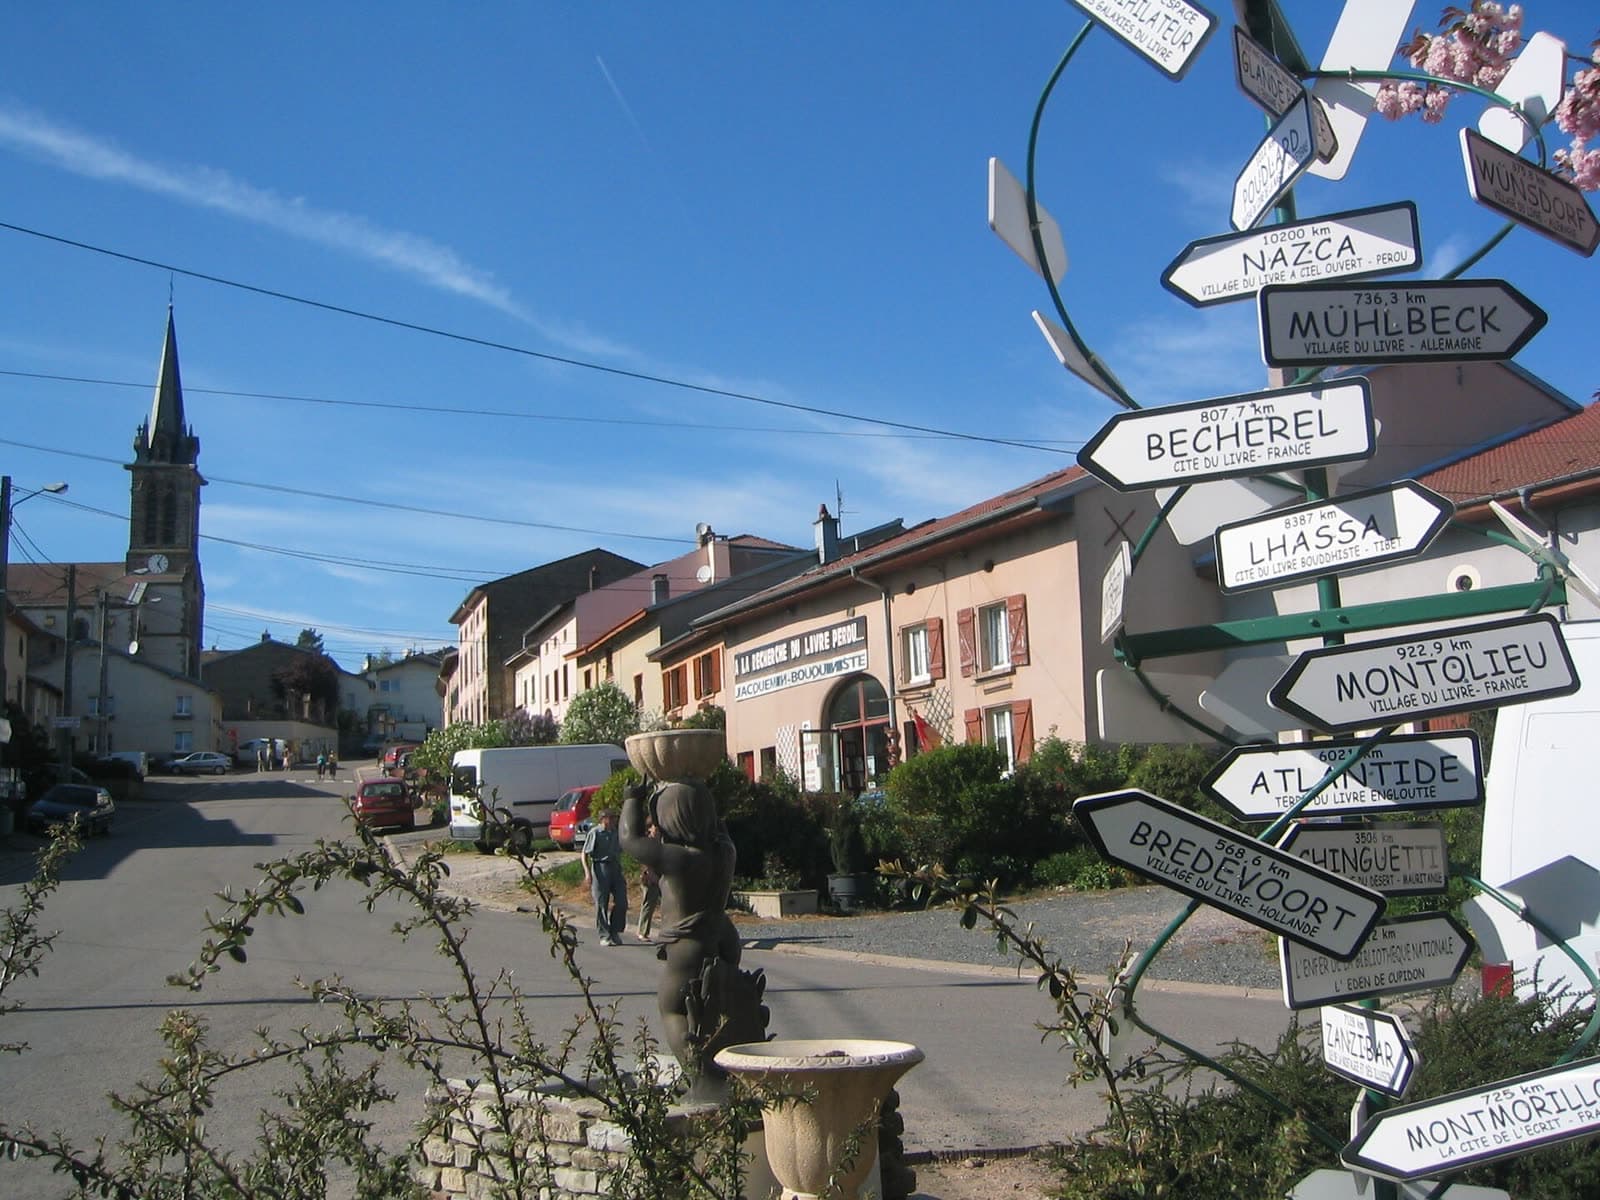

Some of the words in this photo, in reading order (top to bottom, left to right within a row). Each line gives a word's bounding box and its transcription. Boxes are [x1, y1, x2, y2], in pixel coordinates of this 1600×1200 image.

[1134, 29, 1146, 43] DU
[1146, 39, 1173, 62] LIVRE
[1263, 230, 1305, 246] 10200
[1312, 226, 1331, 237] km
[1243, 235, 1356, 275] NAZCA
[1201, 282, 1239, 296] VILLAGE
[1242, 278, 1255, 289] DU
[1259, 272, 1286, 286] LIVRE
[1290, 270, 1296, 280] A
[1301, 266, 1322, 278] CIEL
[1326, 259, 1363, 273] OUVERT
[1377, 251, 1408, 265] PEROU
[1354, 292, 1398, 306] 736,3
[1406, 292, 1426, 304] km
[1289, 304, 1500, 340] MÜHLBECK
[1304, 341, 1350, 355] VILLAGE
[1355, 340, 1369, 353] DU
[1374, 339, 1405, 352] LIVRE
[1420, 337, 1482, 351] ALLEMAGNE
[1253, 402, 1275, 415] km
[1146, 409, 1338, 461] BECHEREL
[1173, 458, 1200, 473] CITE
[1204, 456, 1219, 470] DU
[1267, 442, 1311, 460] FRANCE
[1284, 512, 1313, 530] 8387
[1320, 508, 1337, 521] km
[1249, 514, 1381, 566] LHASSA
[1234, 567, 1254, 583] CITE
[1258, 565, 1269, 578] DU
[1272, 560, 1297, 574] LIVRE
[1301, 548, 1361, 567] BOUDDHISTE
[1373, 537, 1403, 553] TIBET
[741, 655, 750, 675] LA
[790, 638, 800, 660] DU
[804, 630, 830, 655] LIVRE
[1450, 639, 1473, 651] km
[1335, 641, 1547, 703] MONTOLIEU
[1369, 694, 1418, 713] VILLAGE
[1422, 690, 1438, 705] DU
[1485, 675, 1529, 695] FRANCE
[1333, 790, 1366, 804] LIVRE
[1371, 785, 1436, 801] ENGLOUTIE
[1129, 820, 1356, 931] BREDEVOORT
[1268, 863, 1290, 881] km
[1146, 855, 1194, 884] VILLAGE
[1195, 876, 1213, 891] DU
[1257, 903, 1320, 938] HOLLANDE
[1382, 927, 1396, 940] km
[1347, 976, 1371, 991] EDEN
[1375, 973, 1386, 987] DE
[1388, 968, 1425, 984] CUPIDON
[1326, 1022, 1394, 1068] ZANZIBAR
[1481, 1089, 1516, 1105] 725
[1520, 1082, 1545, 1095] km
[1439, 1145, 1456, 1159] LA
[1460, 1138, 1488, 1153] CITE
[1493, 1133, 1509, 1146] DE
[1515, 1118, 1562, 1140] L'ECRIT
